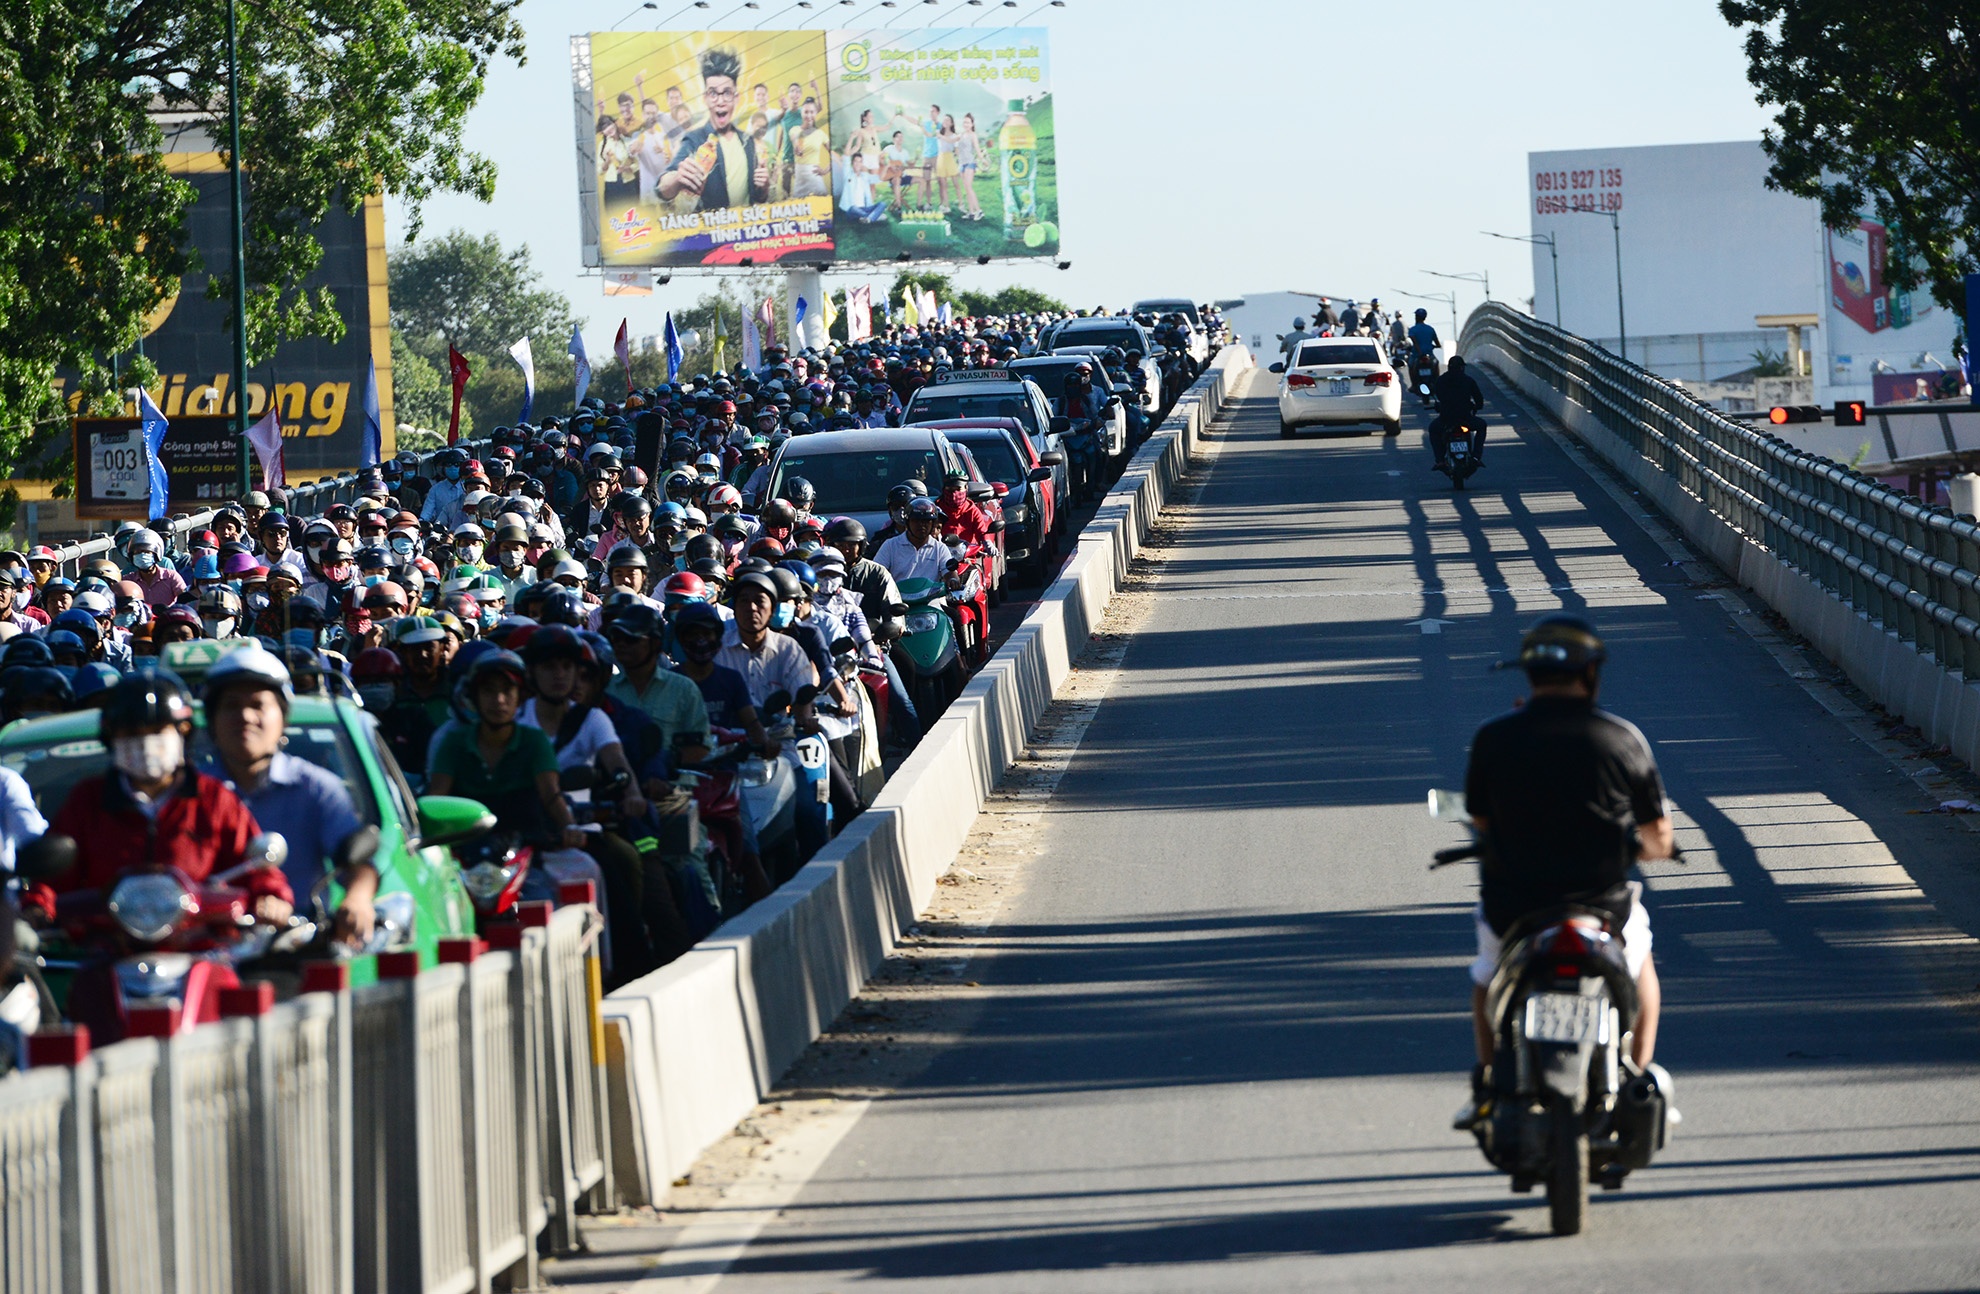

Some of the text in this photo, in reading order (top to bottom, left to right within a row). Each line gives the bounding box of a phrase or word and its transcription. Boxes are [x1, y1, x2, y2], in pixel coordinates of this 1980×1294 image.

[880, 63, 913, 81] Giải
[916, 64, 955, 83] nhiệt
[960, 63, 998, 83] cuộc
[1002, 61, 1040, 82] sống
[1536, 168, 1622, 191] 0913 927 135
[1600, 192, 1622, 211] 180
[658, 213, 699, 231] TĂNG
[703, 206, 739, 226] THÊM
[743, 204, 767, 222] SỨC
[953, 371, 1007, 380] VINASUN TAXI
[163, 442, 191, 452] Công
[194, 440, 219, 452] nghệ
[104, 449, 136, 470] 003
[110, 472, 137, 481] COOL
